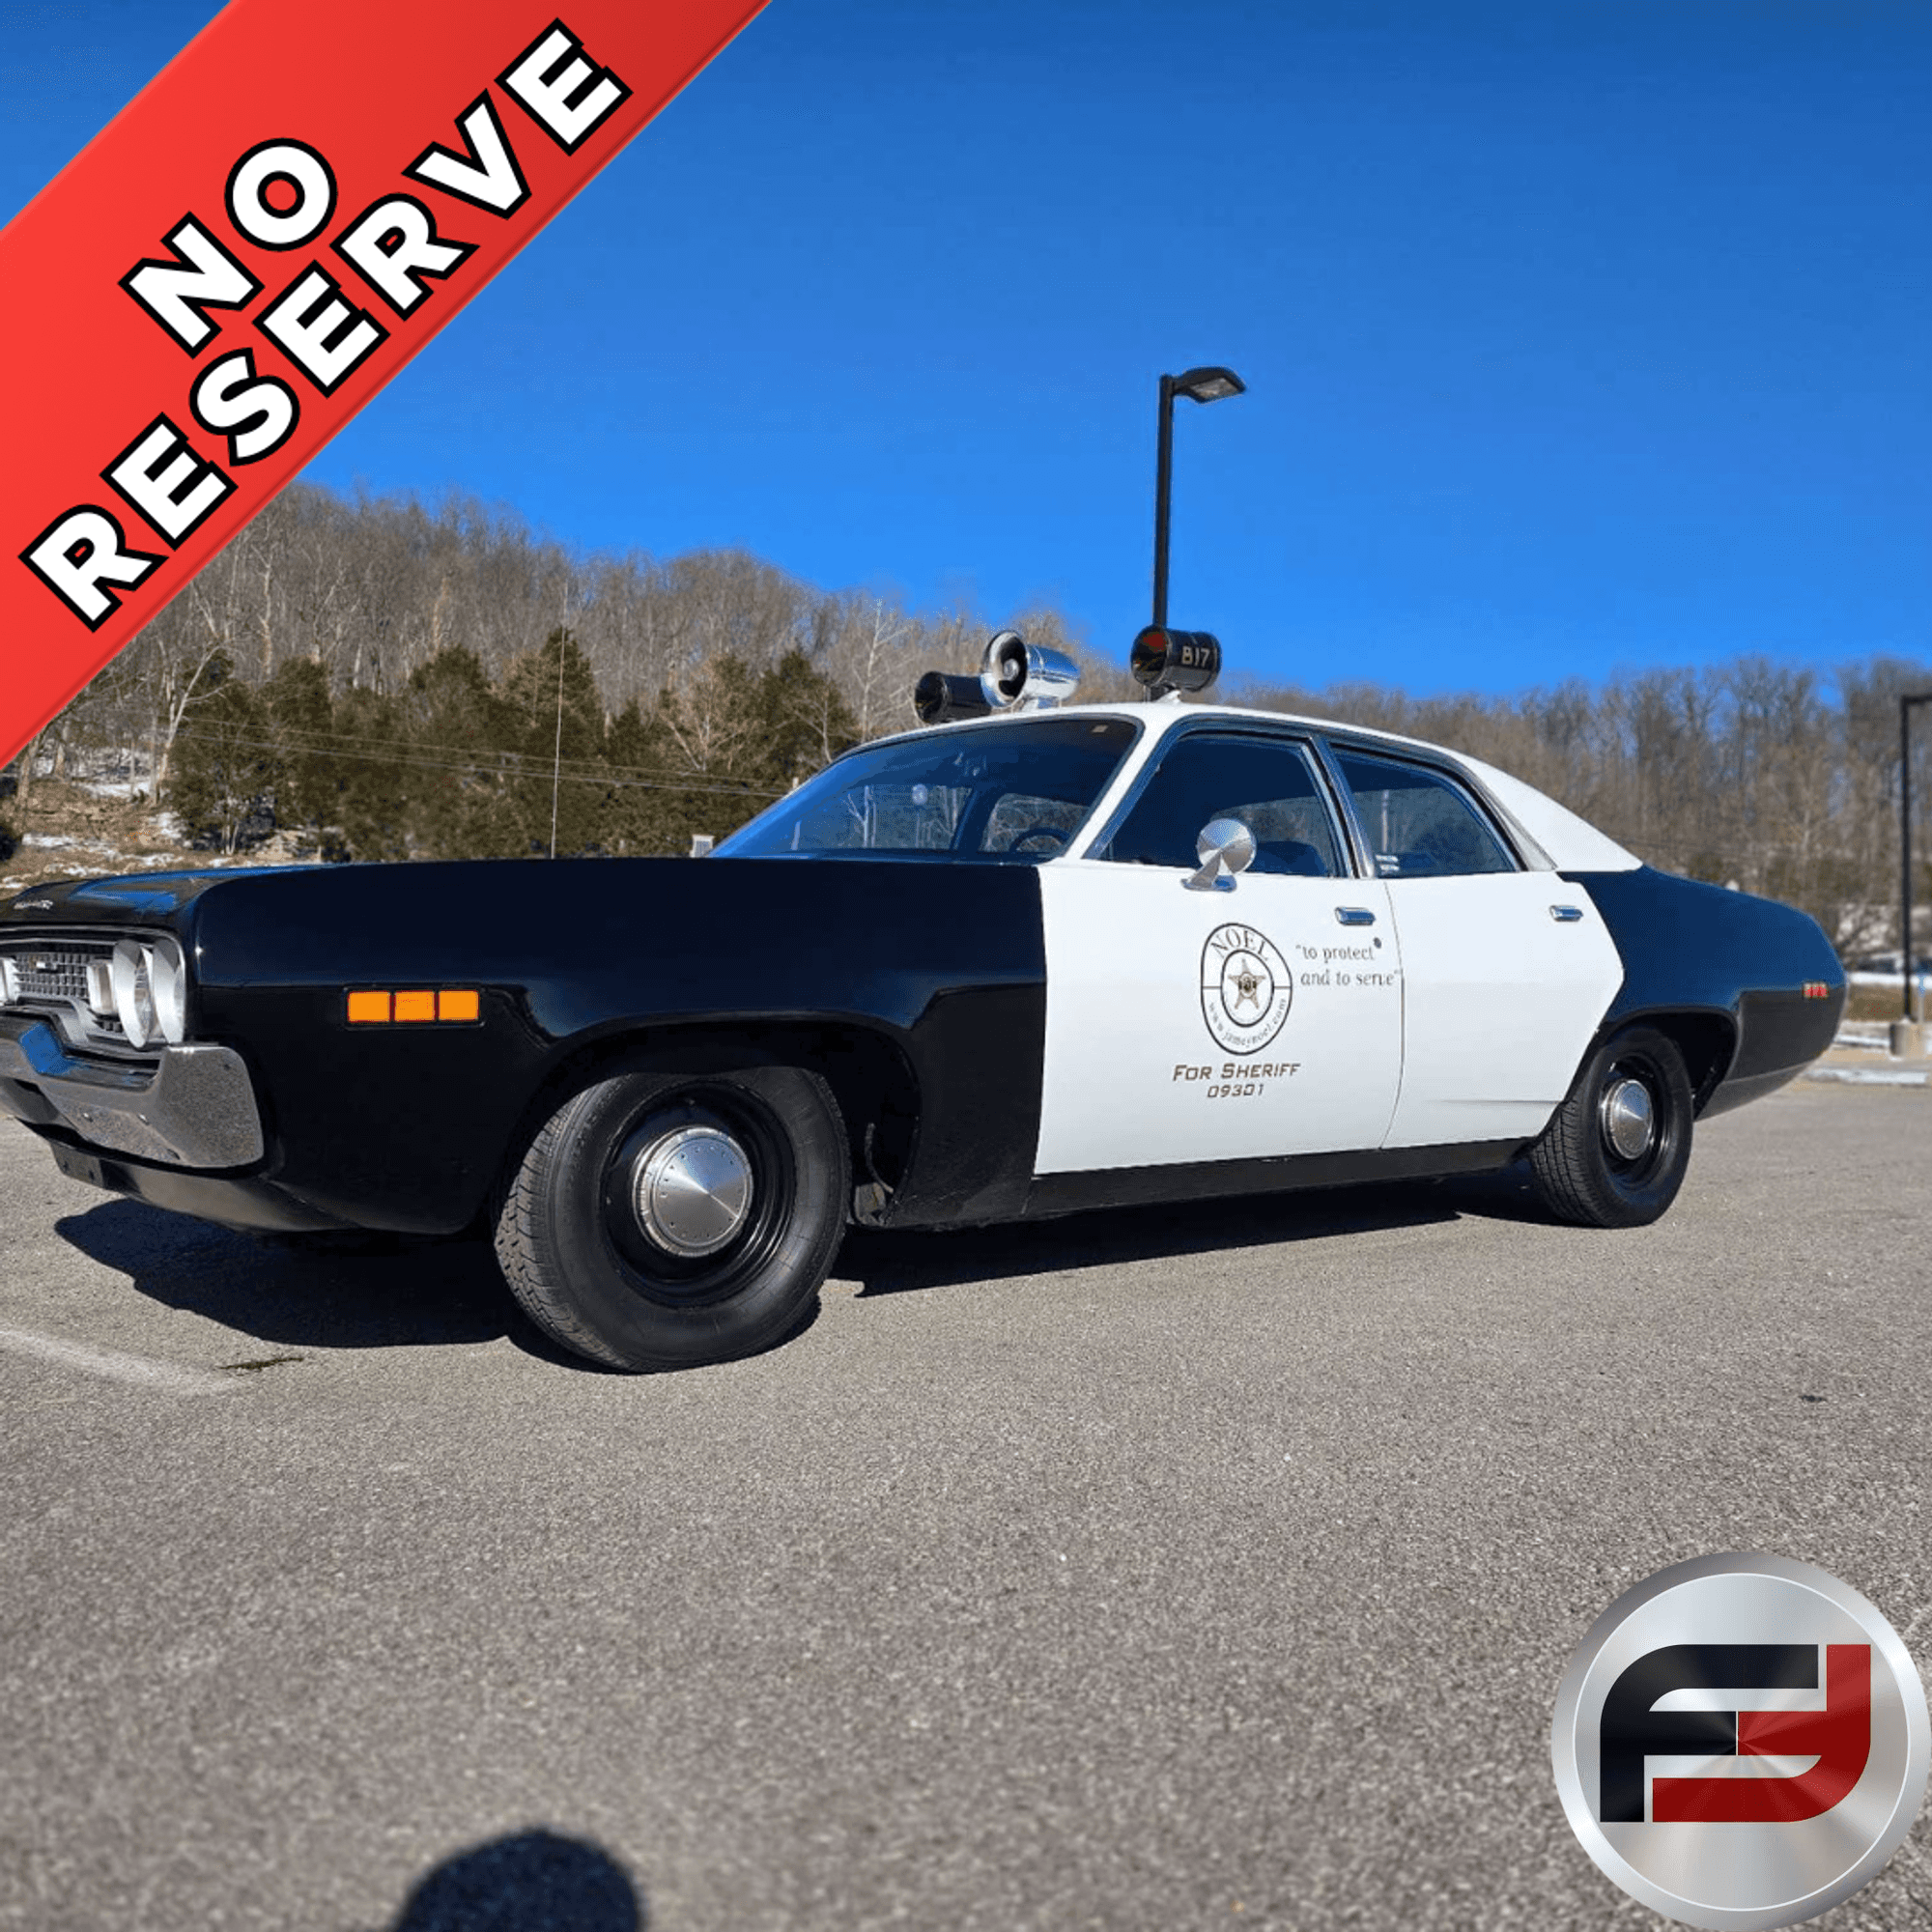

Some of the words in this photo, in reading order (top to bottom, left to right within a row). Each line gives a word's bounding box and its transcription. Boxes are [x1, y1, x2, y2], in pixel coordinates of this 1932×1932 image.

[1210, 927, 1269, 961] NOEL
[1322, 946, 1375, 964] protect
[1300, 969, 1330, 986] and
[1336, 971, 1350, 986] to
[1220, 1063, 1301, 1079] SHERIFF
[1208, 1083, 1264, 1098] 09301
